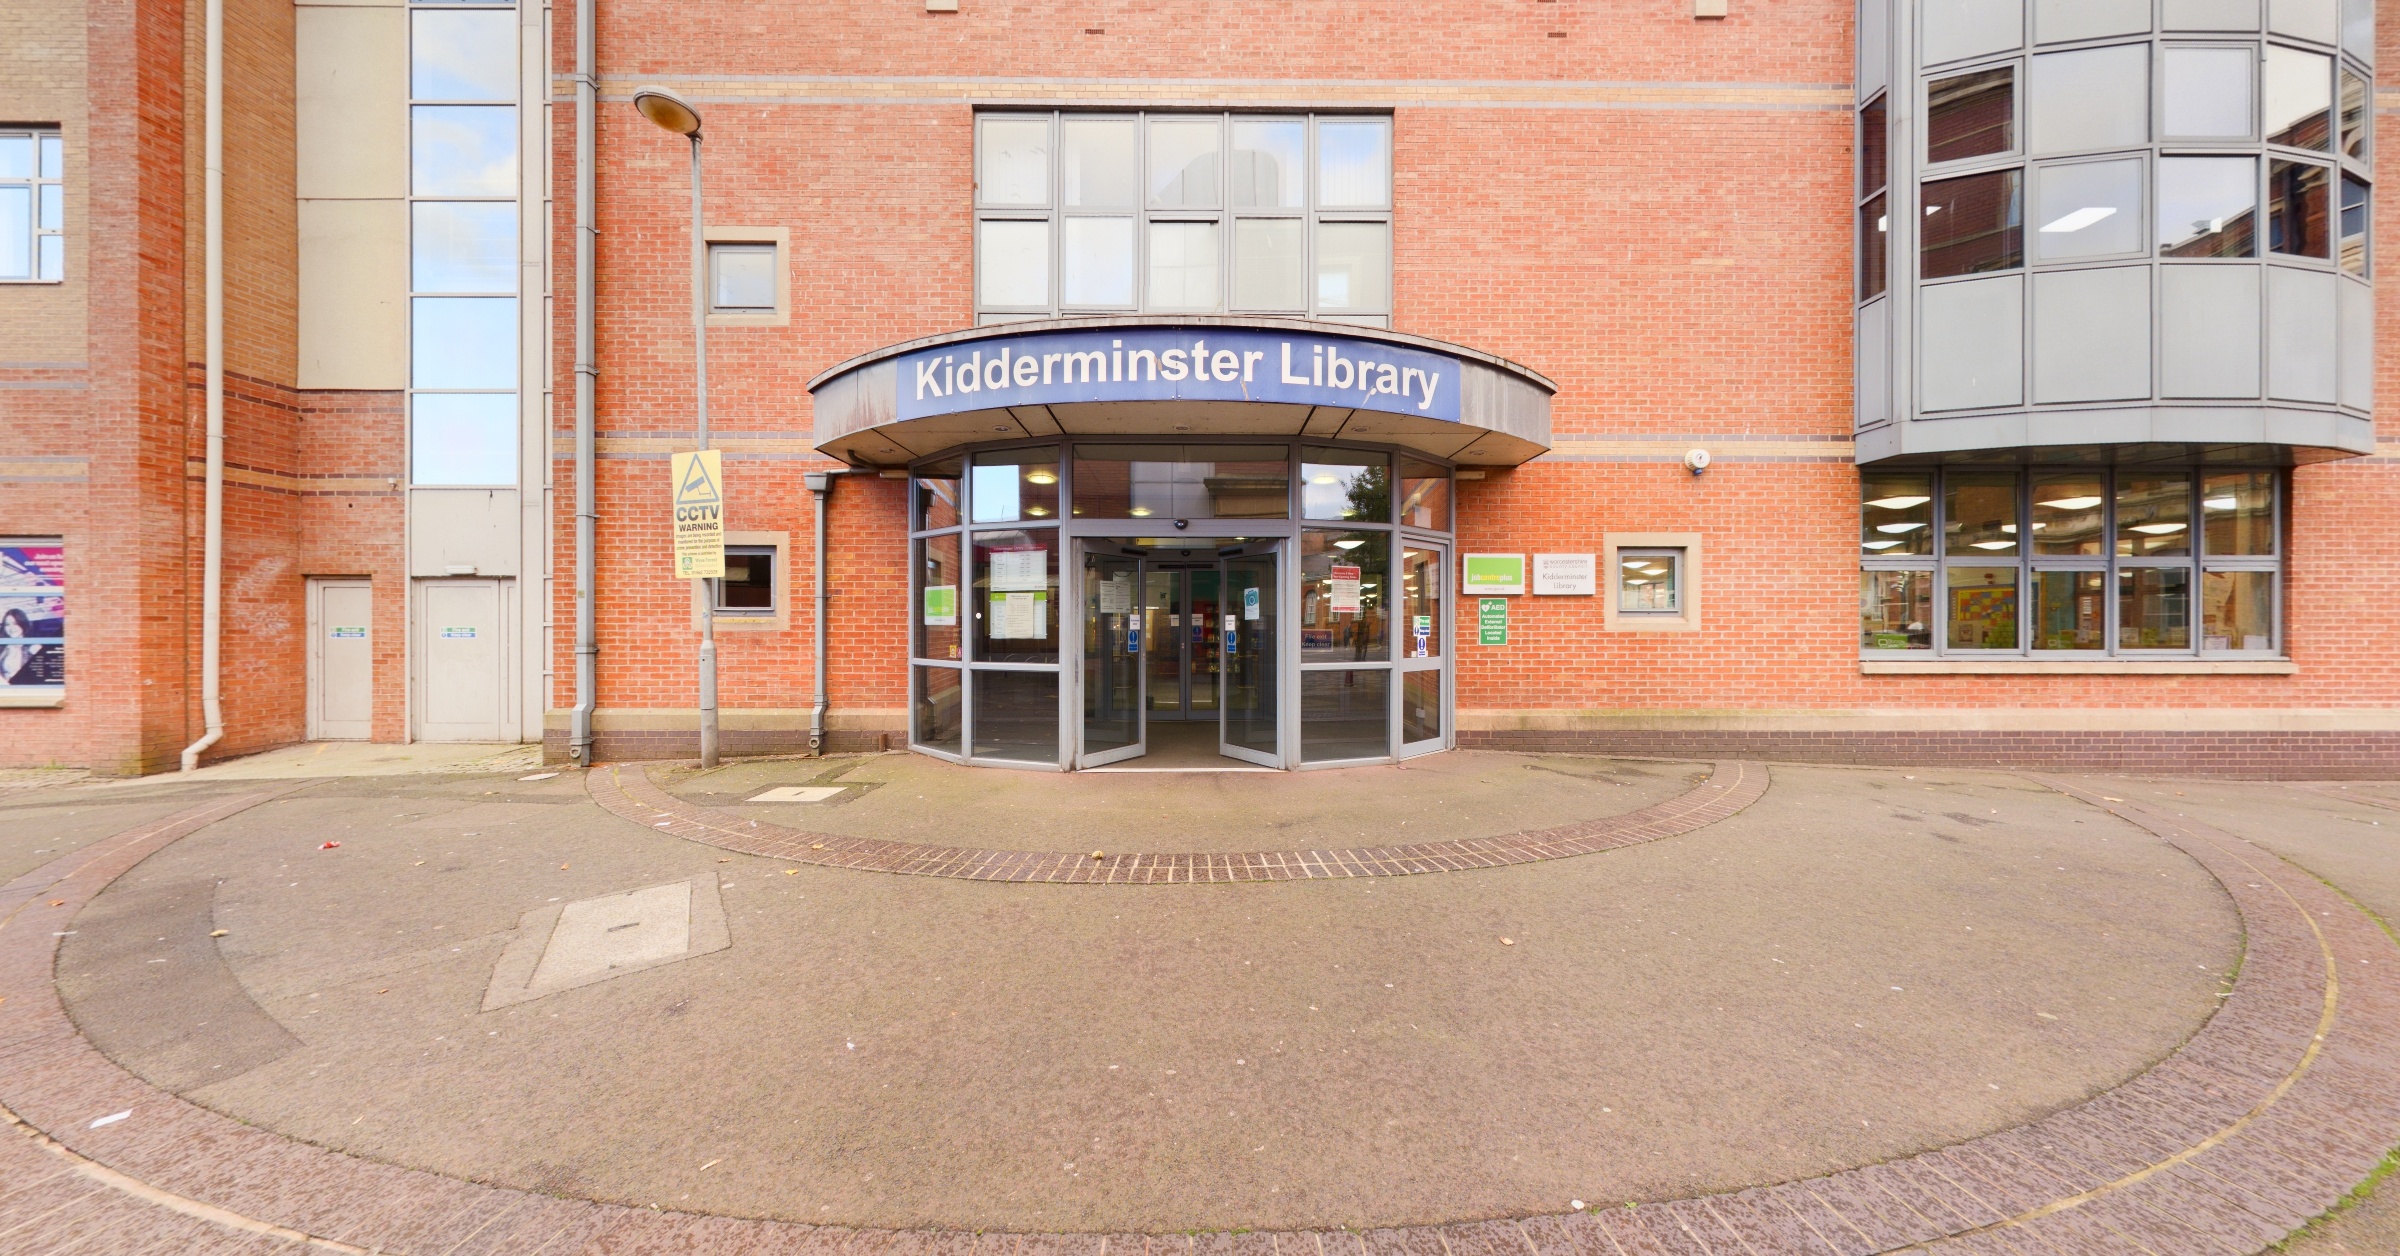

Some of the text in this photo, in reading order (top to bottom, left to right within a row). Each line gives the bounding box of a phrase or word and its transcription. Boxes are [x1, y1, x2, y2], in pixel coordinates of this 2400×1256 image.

[915, 339, 1439, 410] Kidderminster Library
[676, 505, 720, 522] CCTV
[679, 522, 718, 532] WARNING
[1471, 573, 1513, 583] jobcentreplus
[1553, 582, 1577, 590] Library
